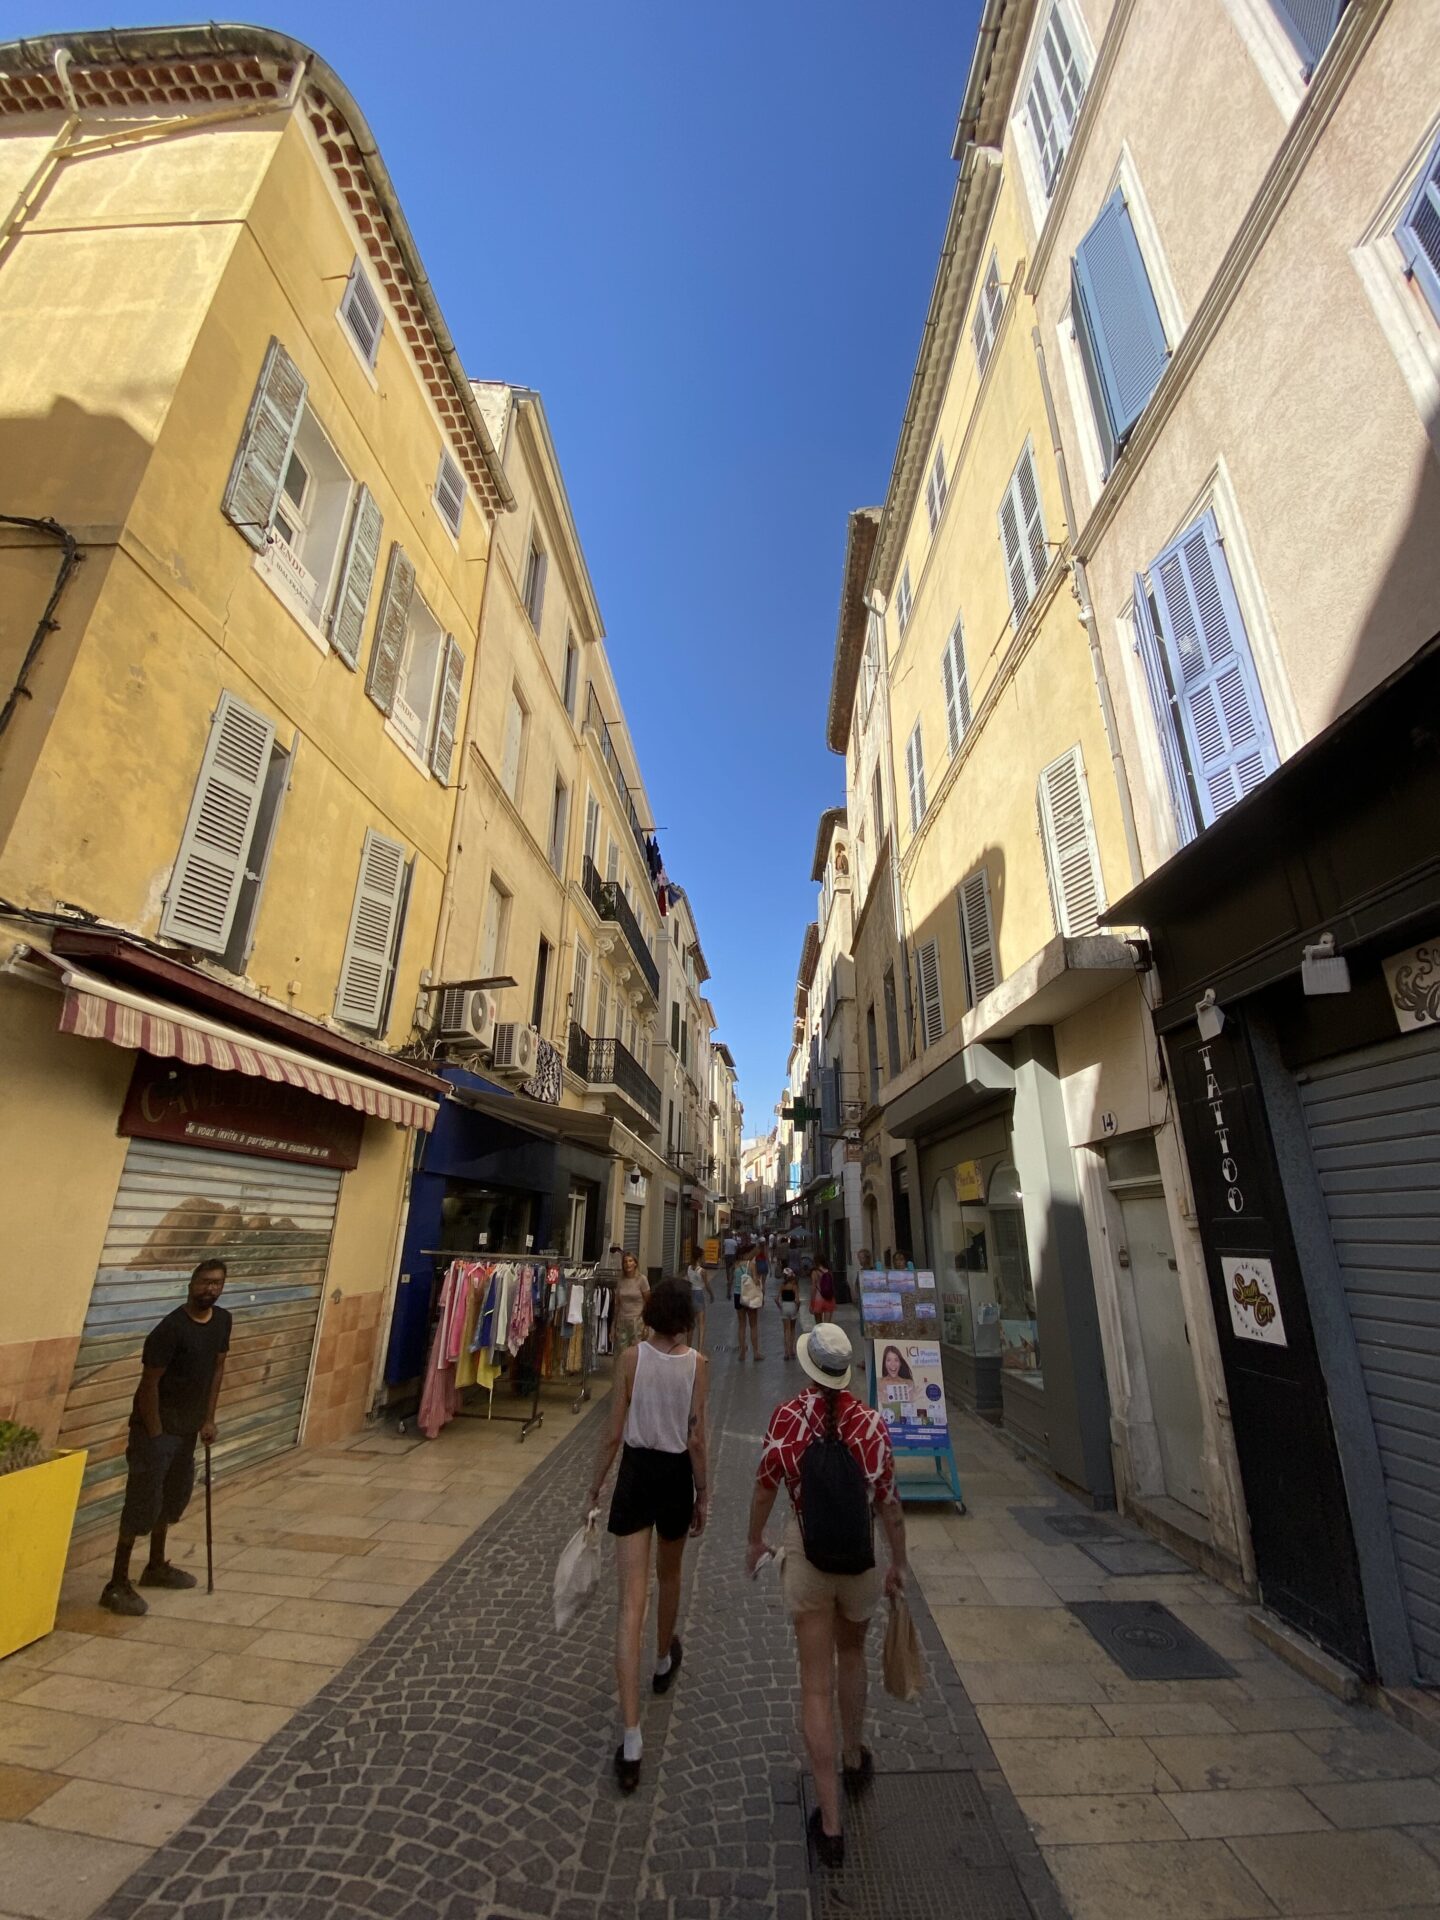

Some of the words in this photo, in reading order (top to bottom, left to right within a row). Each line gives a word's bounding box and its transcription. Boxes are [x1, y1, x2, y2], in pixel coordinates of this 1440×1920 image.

[274, 533, 306, 578] VENDU
[1102, 1113, 1114, 1132] 14
[1198, 1045, 1243, 1213] TATTOO
[198, 1127, 214, 1137] vous
[217, 1128, 237, 1141] invite
[905, 1346, 920, 1358] ICI
